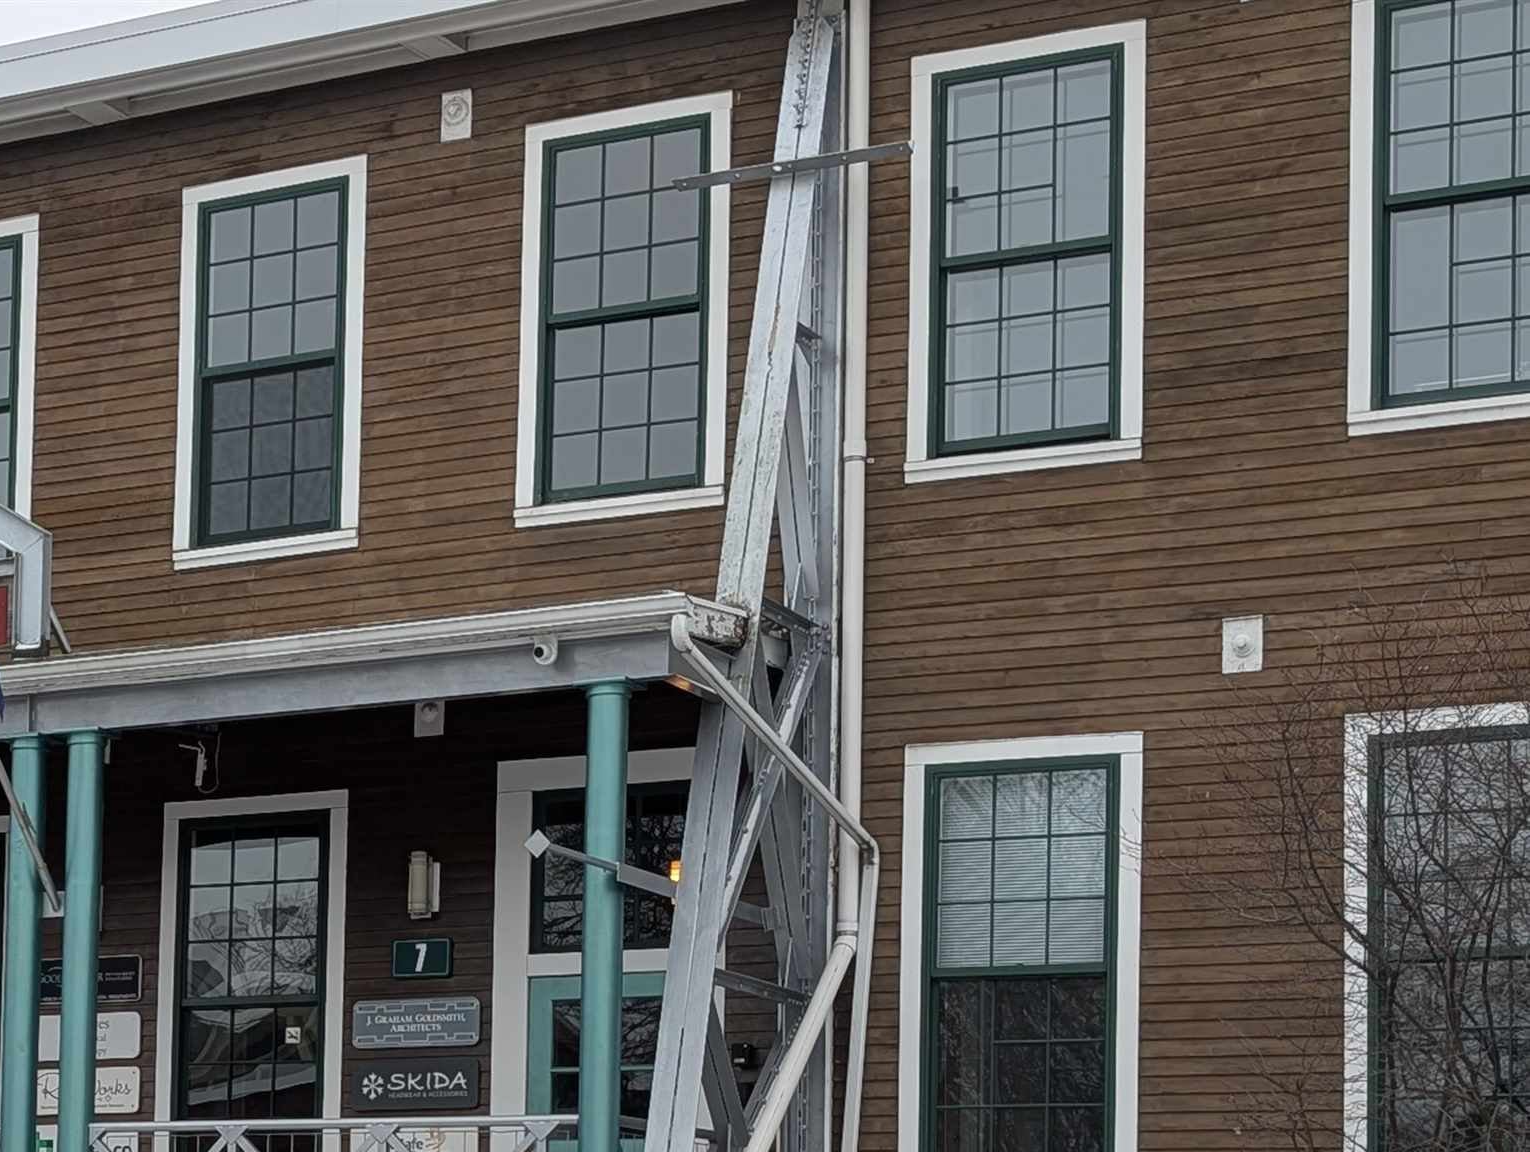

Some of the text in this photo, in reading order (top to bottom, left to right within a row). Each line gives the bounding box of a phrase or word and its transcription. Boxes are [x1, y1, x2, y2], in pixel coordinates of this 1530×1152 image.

[413, 943, 427, 972] 7
[374, 1014, 412, 1024] GRAHAM
[390, 1023, 442, 1033] ARCHITECTS
[387, 1071, 468, 1091] SKIDA
